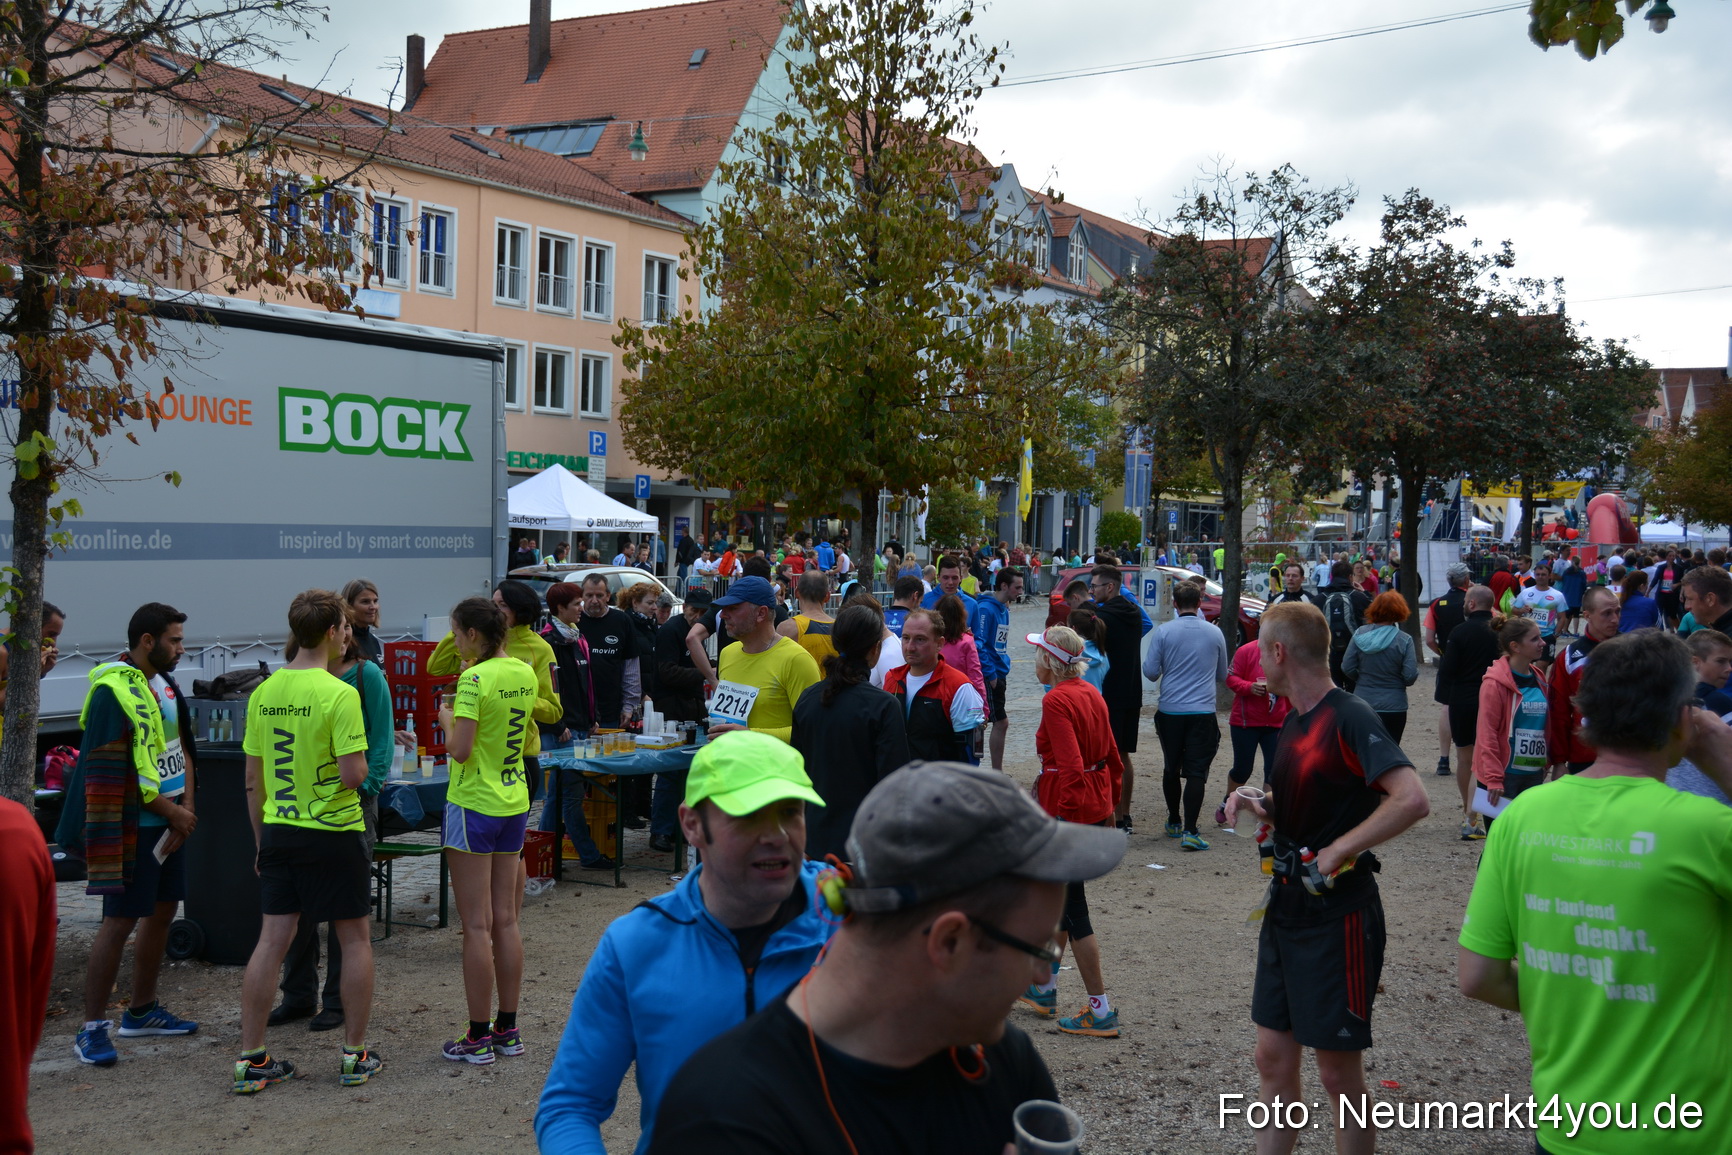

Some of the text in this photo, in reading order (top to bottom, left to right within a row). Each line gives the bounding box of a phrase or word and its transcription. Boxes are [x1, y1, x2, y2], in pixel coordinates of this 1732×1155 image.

[145, 391, 253, 426] LOUNGE
[281, 391, 470, 457] BOCK
[593, 433, 603, 453] P
[507, 450, 589, 472] EICHMAN
[638, 477, 647, 496] P
[596, 518, 643, 530] BMW Laufsport
[279, 530, 474, 553] inspired by smart concepts
[1146, 582, 1154, 595] P
[592, 647, 618, 655] movin'
[498, 689, 519, 699] Team
[713, 692, 750, 718] 2214
[259, 705, 287, 716] Team
[348, 733, 364, 741] Team
[500, 707, 526, 787] BMW
[273, 727, 300, 819] BMW
[1519, 830, 1625, 854] SÜDWESTPARK
[1551, 853, 1576, 864] Denn
[1578, 856, 1616, 867] Standort
[1524, 893, 1616, 921] Wer laufend
[1574, 922, 1657, 955] denkt,
[1522, 941, 1616, 986] bewegt
[1604, 983, 1656, 1003] was!
